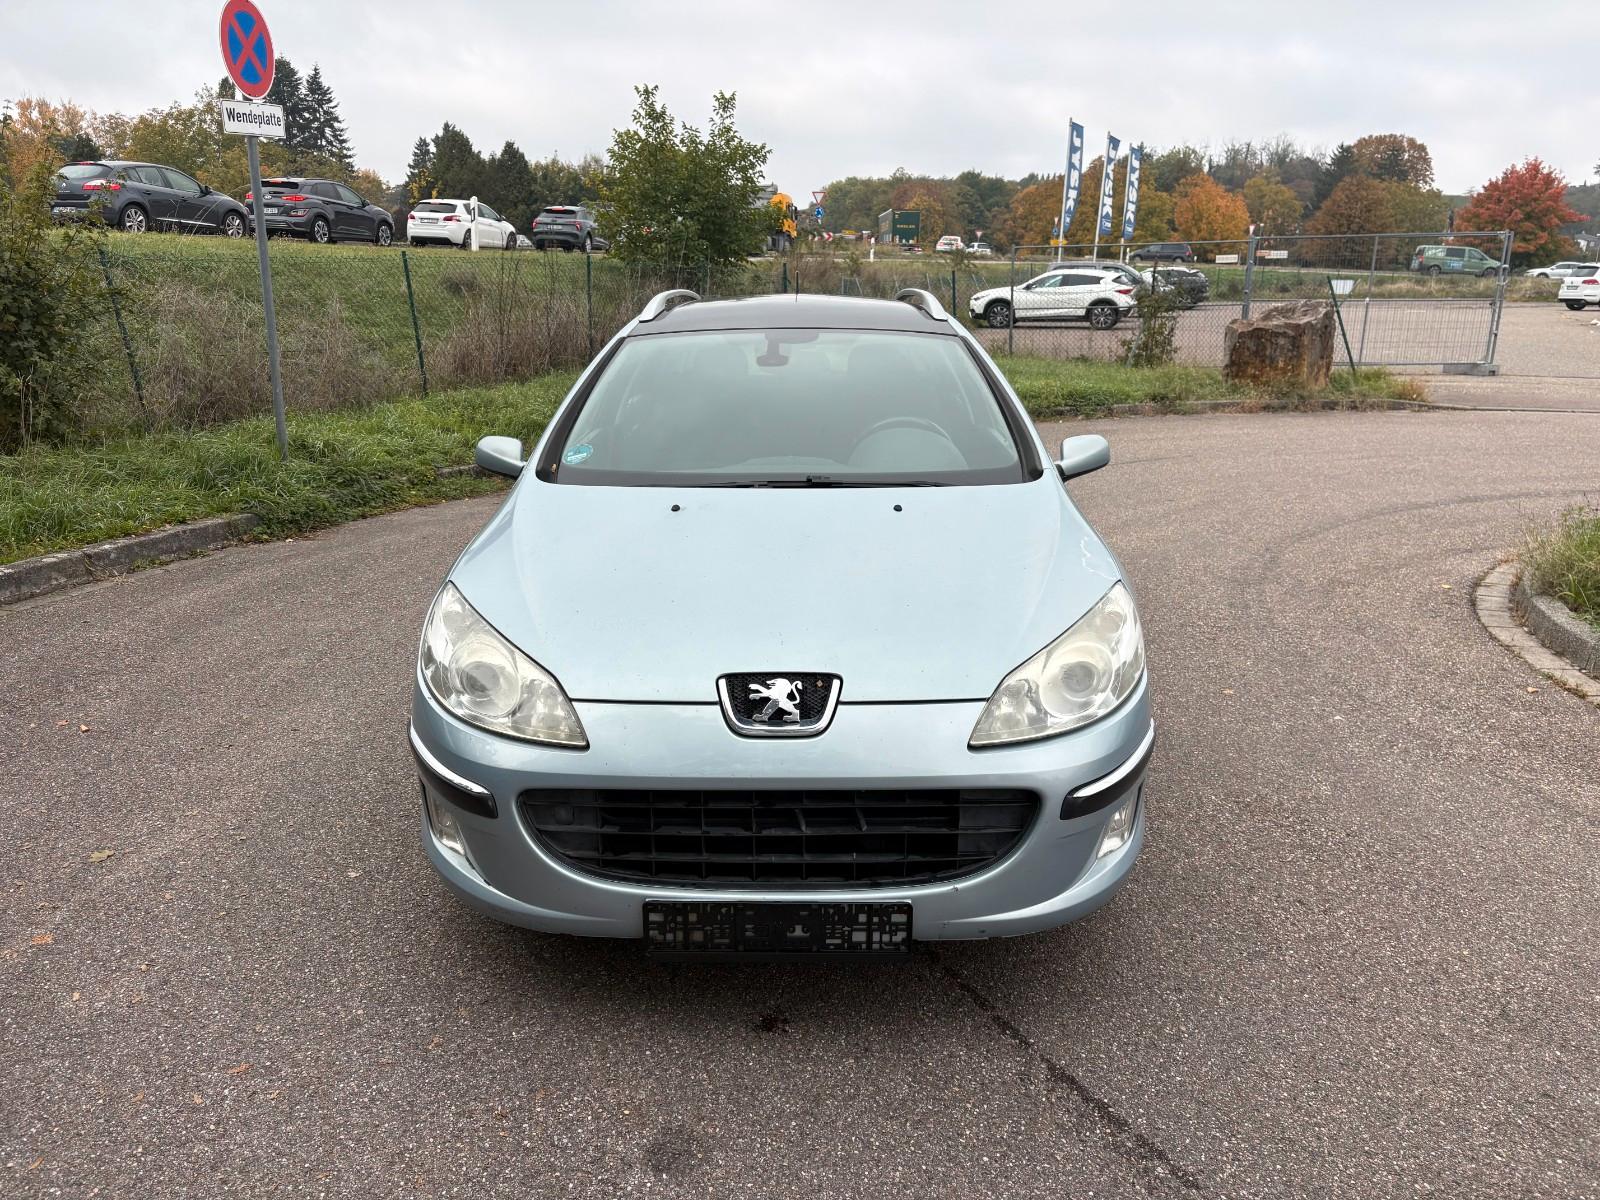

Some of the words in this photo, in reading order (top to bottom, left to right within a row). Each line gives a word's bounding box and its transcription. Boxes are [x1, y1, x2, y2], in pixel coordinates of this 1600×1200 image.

[226, 107, 282, 128] Wendeplatte
[1065, 129, 1081, 212] JYSK
[1103, 143, 1116, 217] JYSK
[1126, 153, 1140, 223] JYSK
